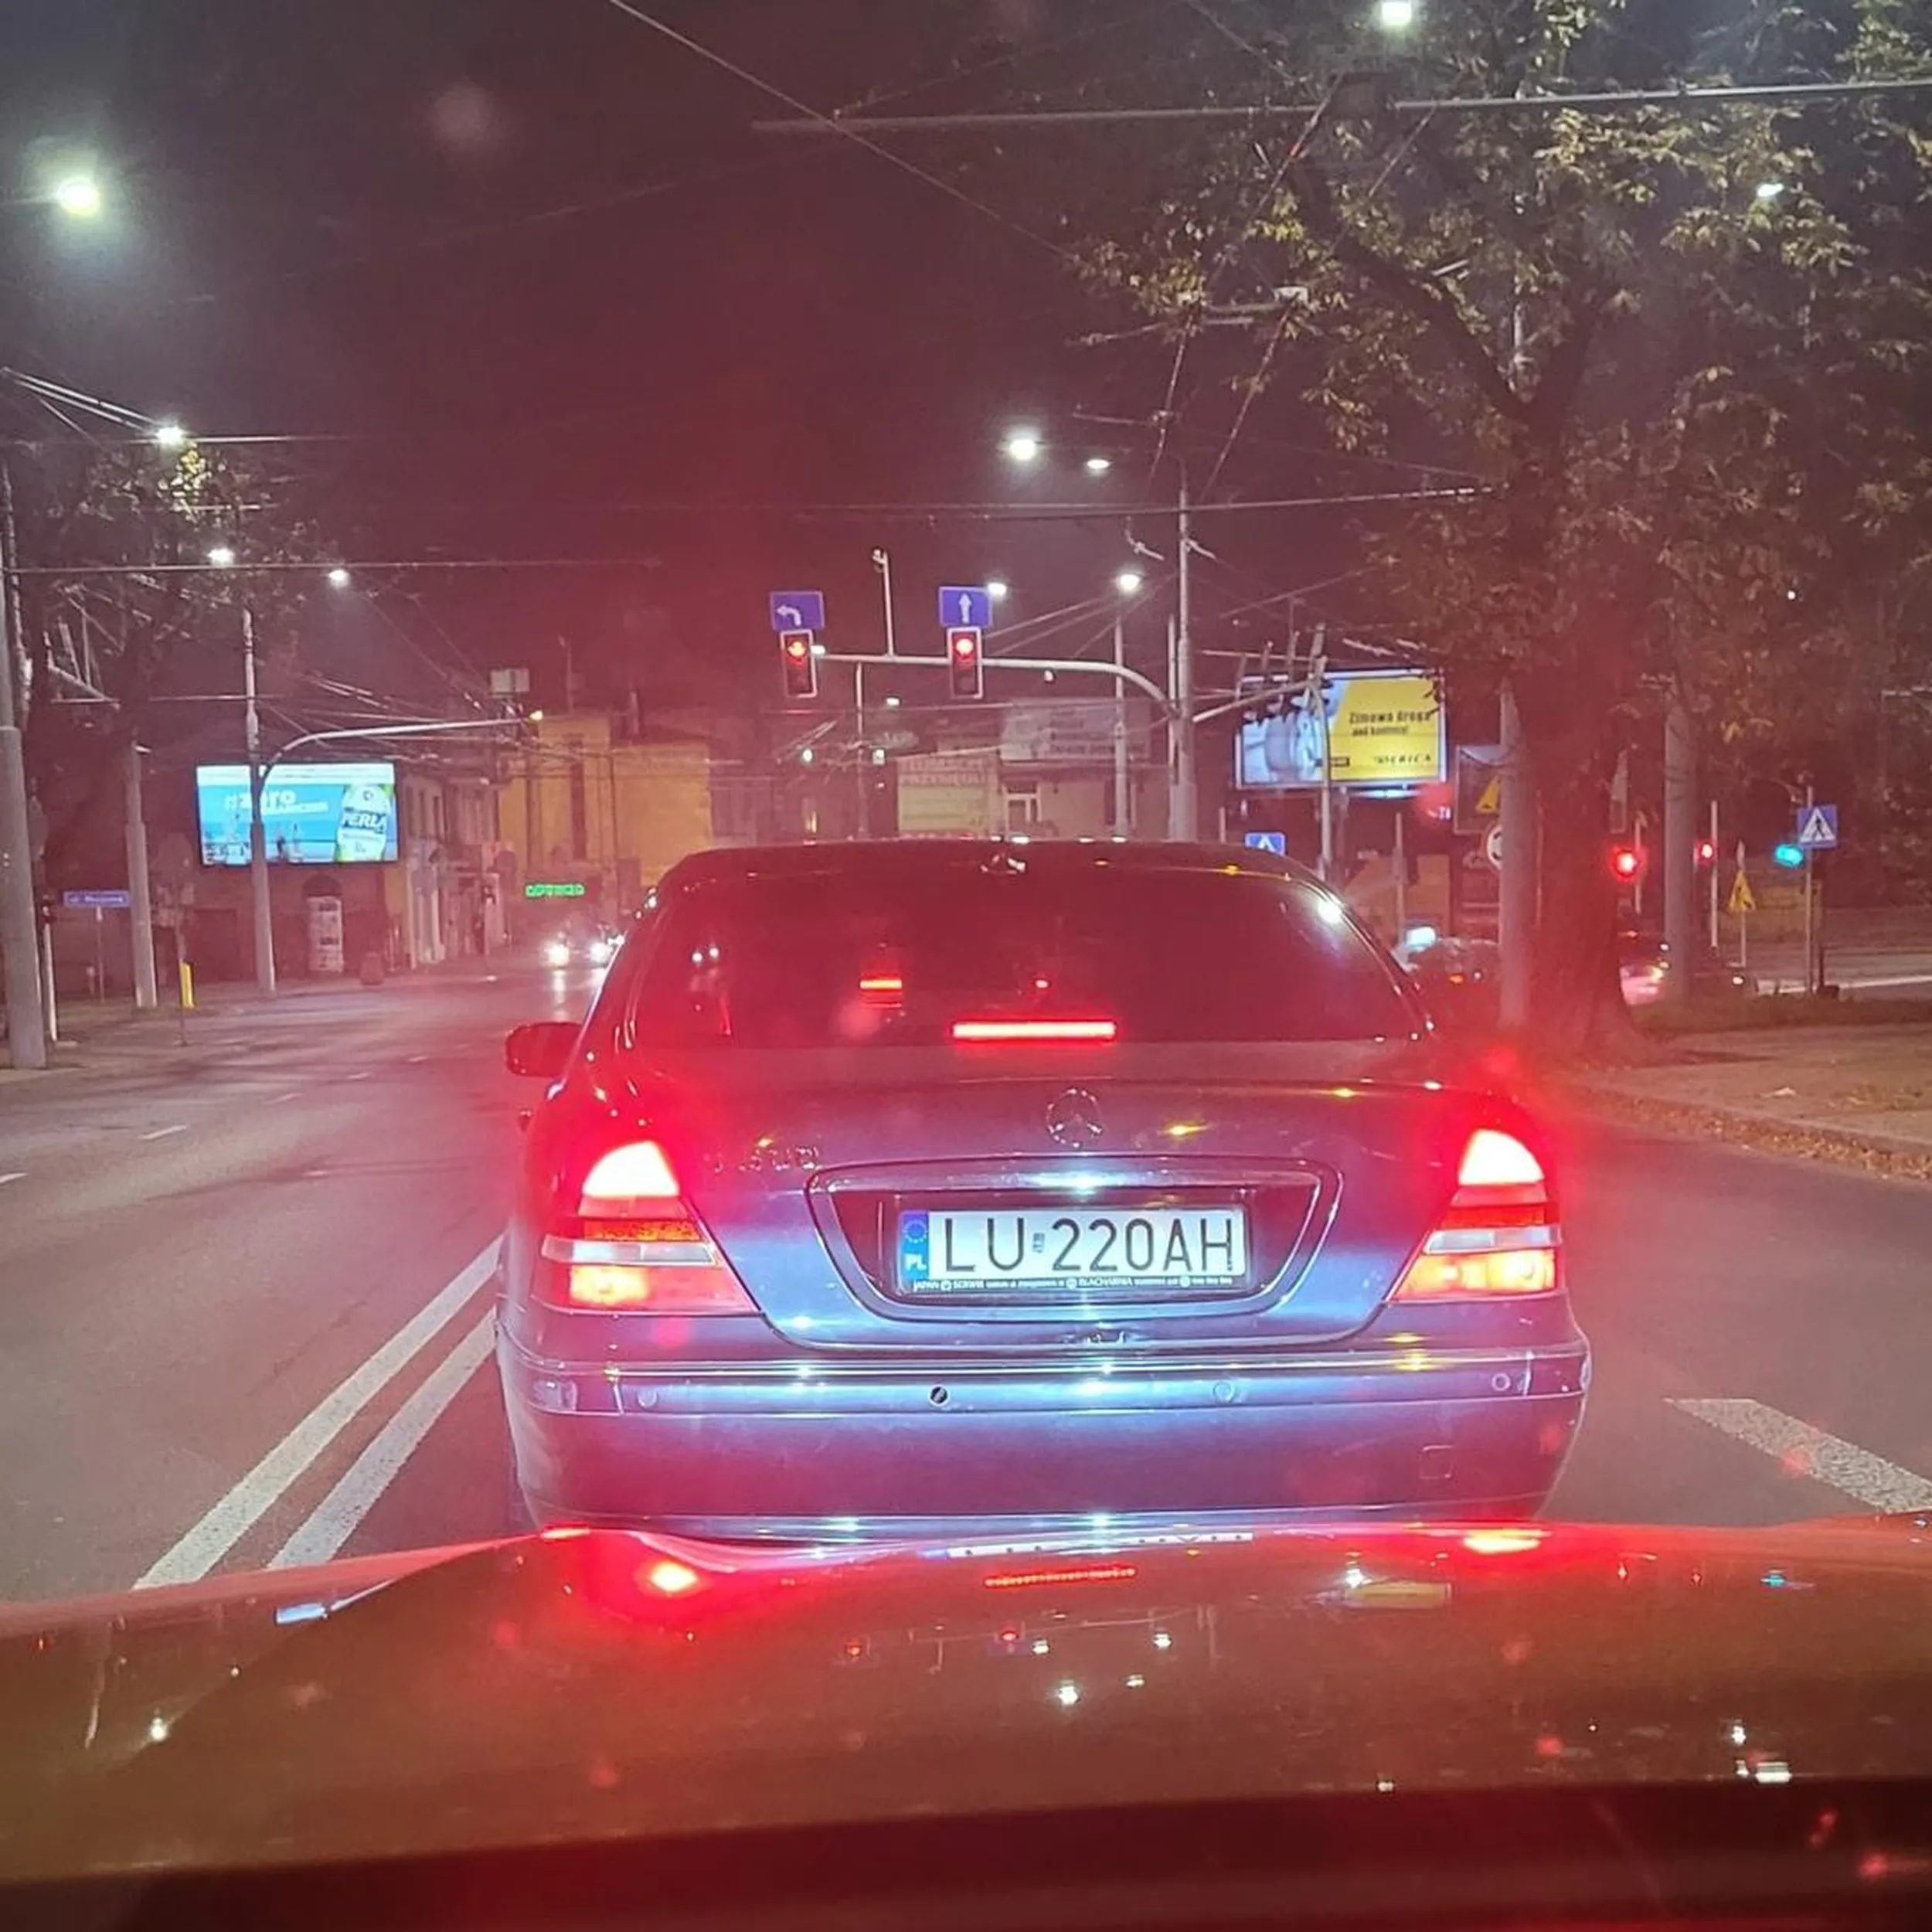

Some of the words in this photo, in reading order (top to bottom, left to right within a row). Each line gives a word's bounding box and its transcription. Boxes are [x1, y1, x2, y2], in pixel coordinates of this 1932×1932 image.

[906, 1254, 927, 1270] PL
[945, 1219, 1025, 1272] LU
[1052, 1218, 1232, 1272] 220AH
